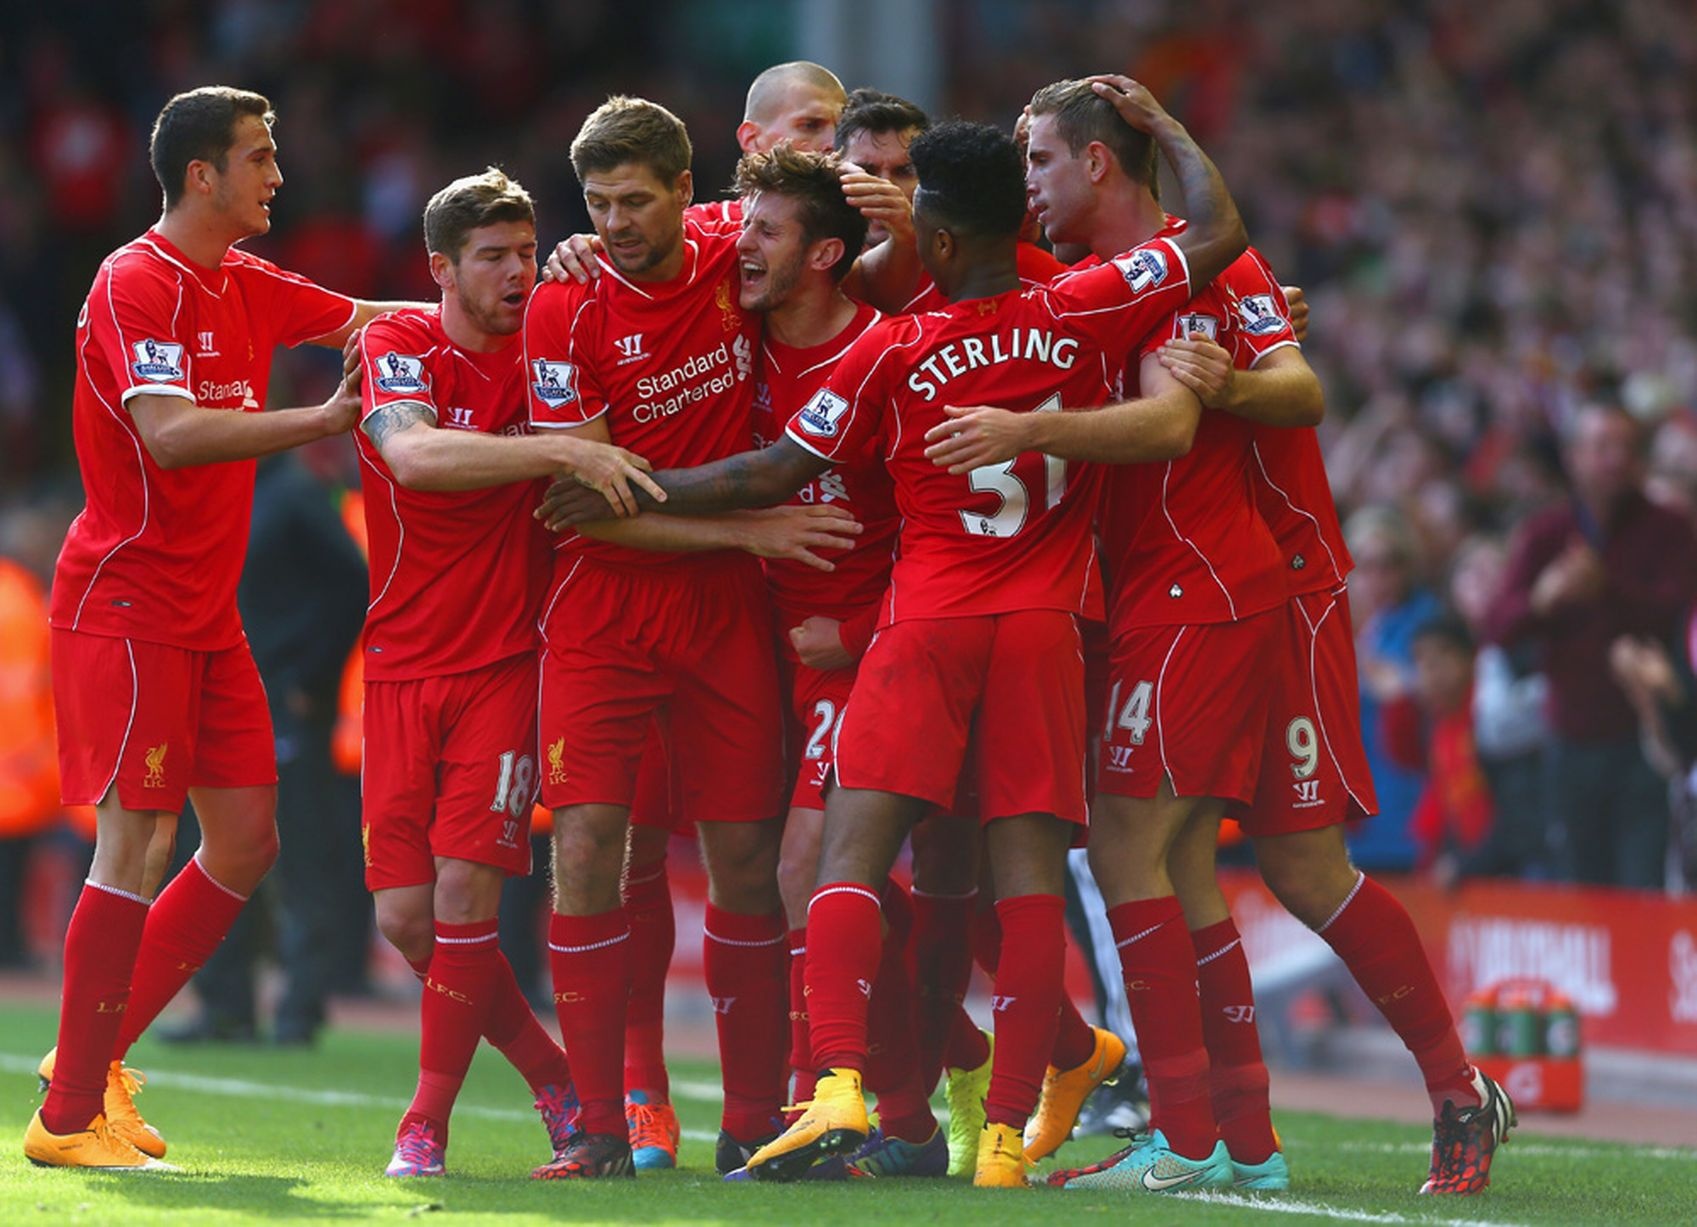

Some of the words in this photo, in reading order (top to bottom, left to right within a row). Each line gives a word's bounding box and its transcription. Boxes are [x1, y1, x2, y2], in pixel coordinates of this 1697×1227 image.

[633, 367, 735, 423] Chartered
[636, 341, 728, 399] Standard
[908, 328, 1079, 401] STERLING
[805, 698, 848, 760] 2
[1104, 679, 1153, 745] 14
[1285, 715, 1319, 779] 9
[489, 749, 534, 817] 18
